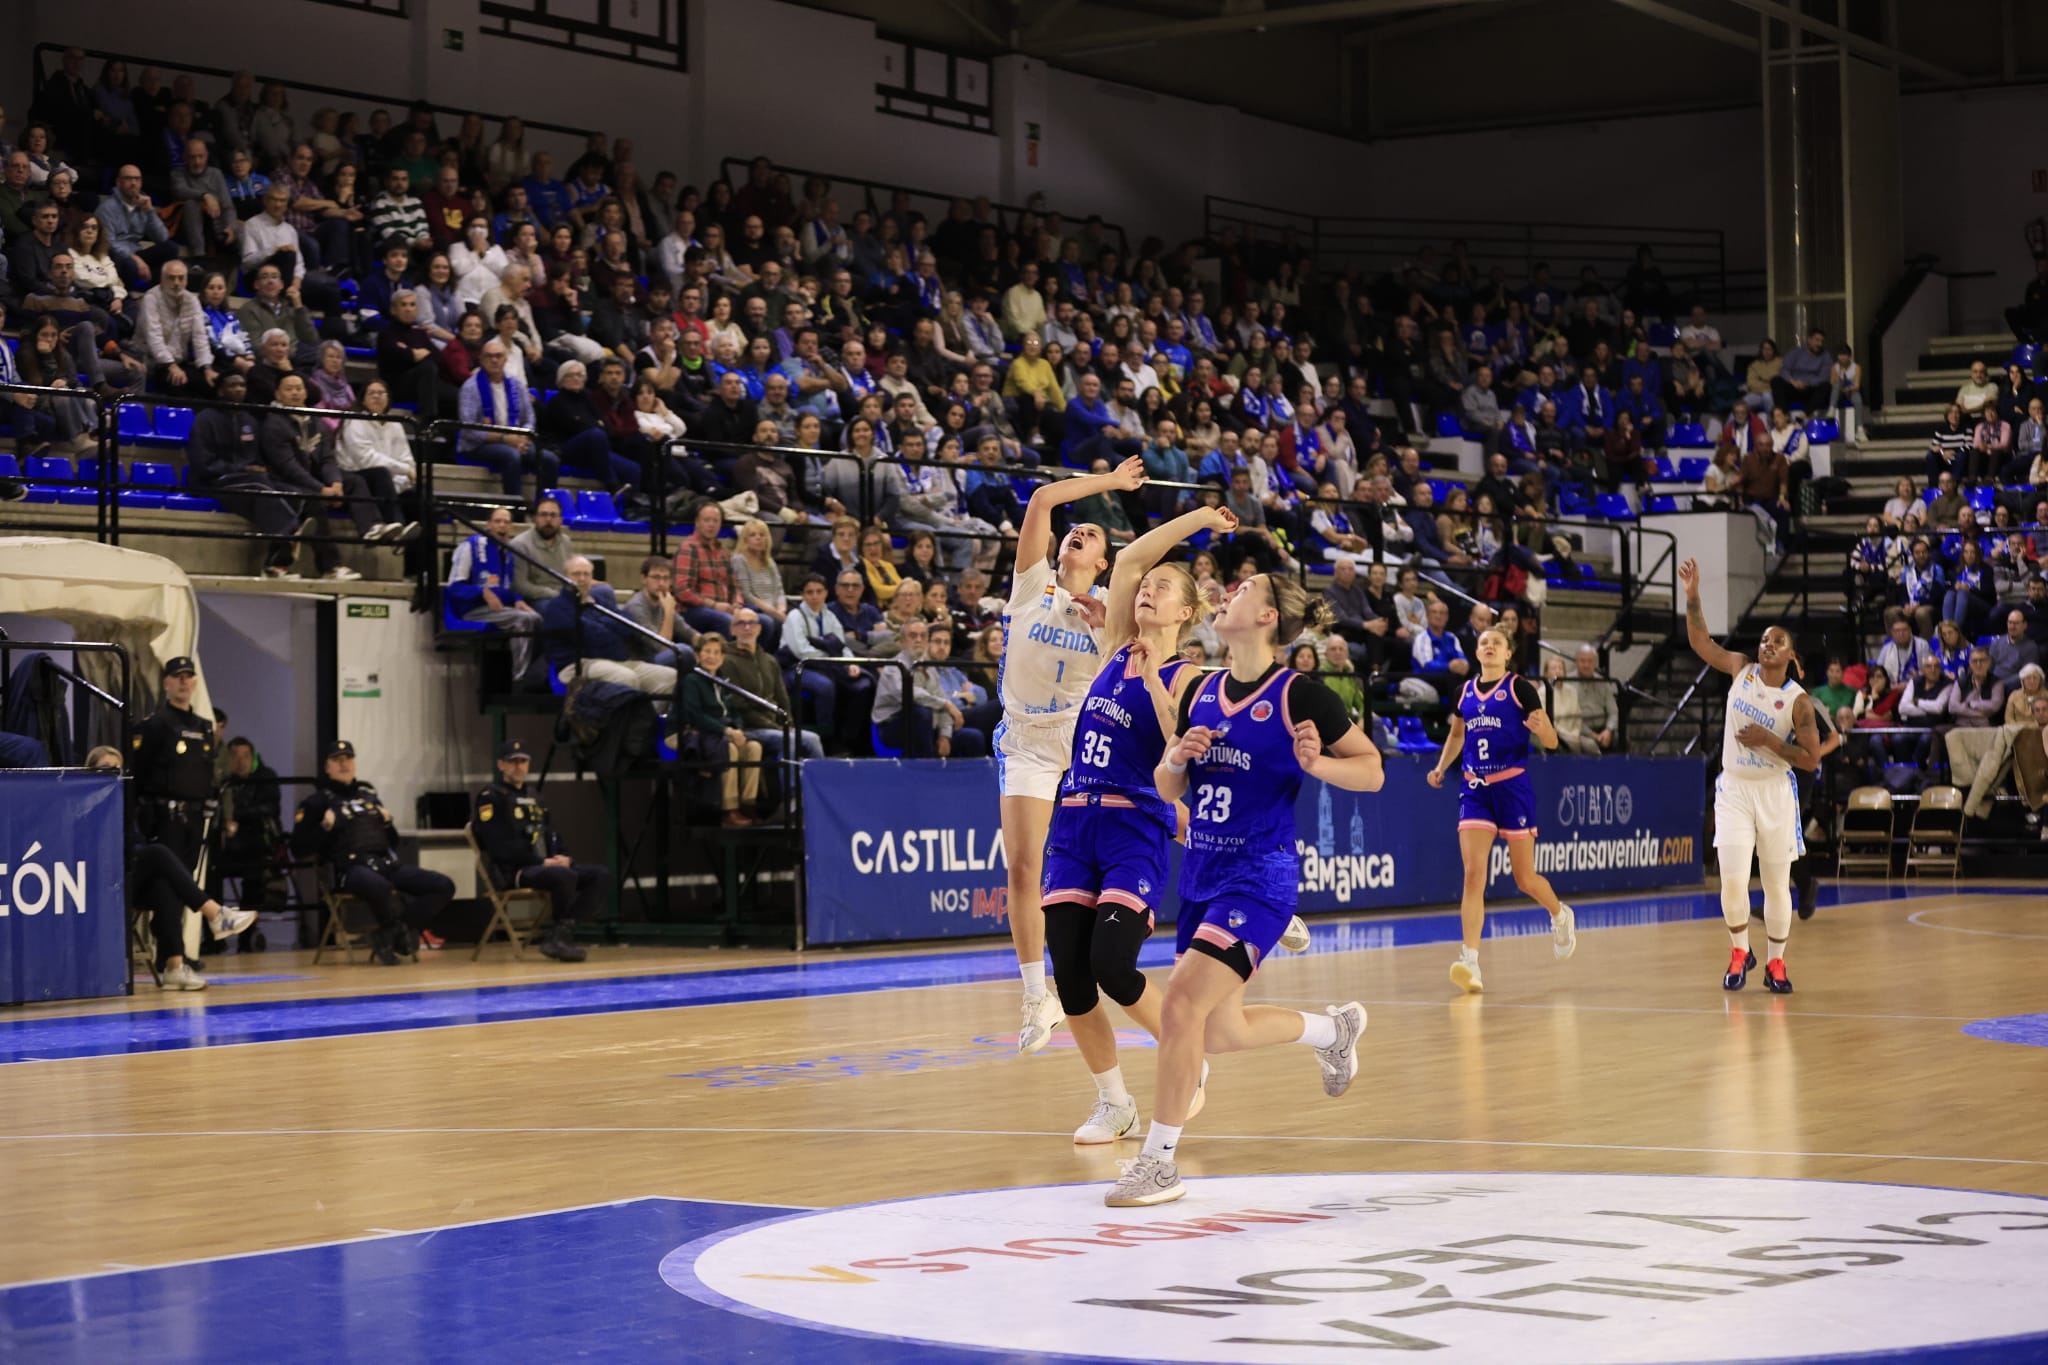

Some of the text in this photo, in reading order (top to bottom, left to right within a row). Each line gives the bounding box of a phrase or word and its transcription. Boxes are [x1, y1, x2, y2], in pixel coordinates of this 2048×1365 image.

[1028, 622, 1099, 655] AVENIDA
[1055, 660, 1065, 683] 1
[1085, 696, 1132, 729] NEPTŪNAS
[1466, 714, 1502, 732] NEPTŪNAS
[1733, 697, 1776, 730] AVENIDA
[1081, 730, 1112, 769] 35
[1477, 738, 1490, 761] 2
[1196, 783, 1232, 823] 23
[851, 828, 1008, 875] CASTILLA
[1489, 828, 1694, 886] pemeriasavenida.com
[930, 888, 970, 913] NOS
[971, 887, 1008, 924] IMP
[1308, 1186, 1518, 1213] NOS
